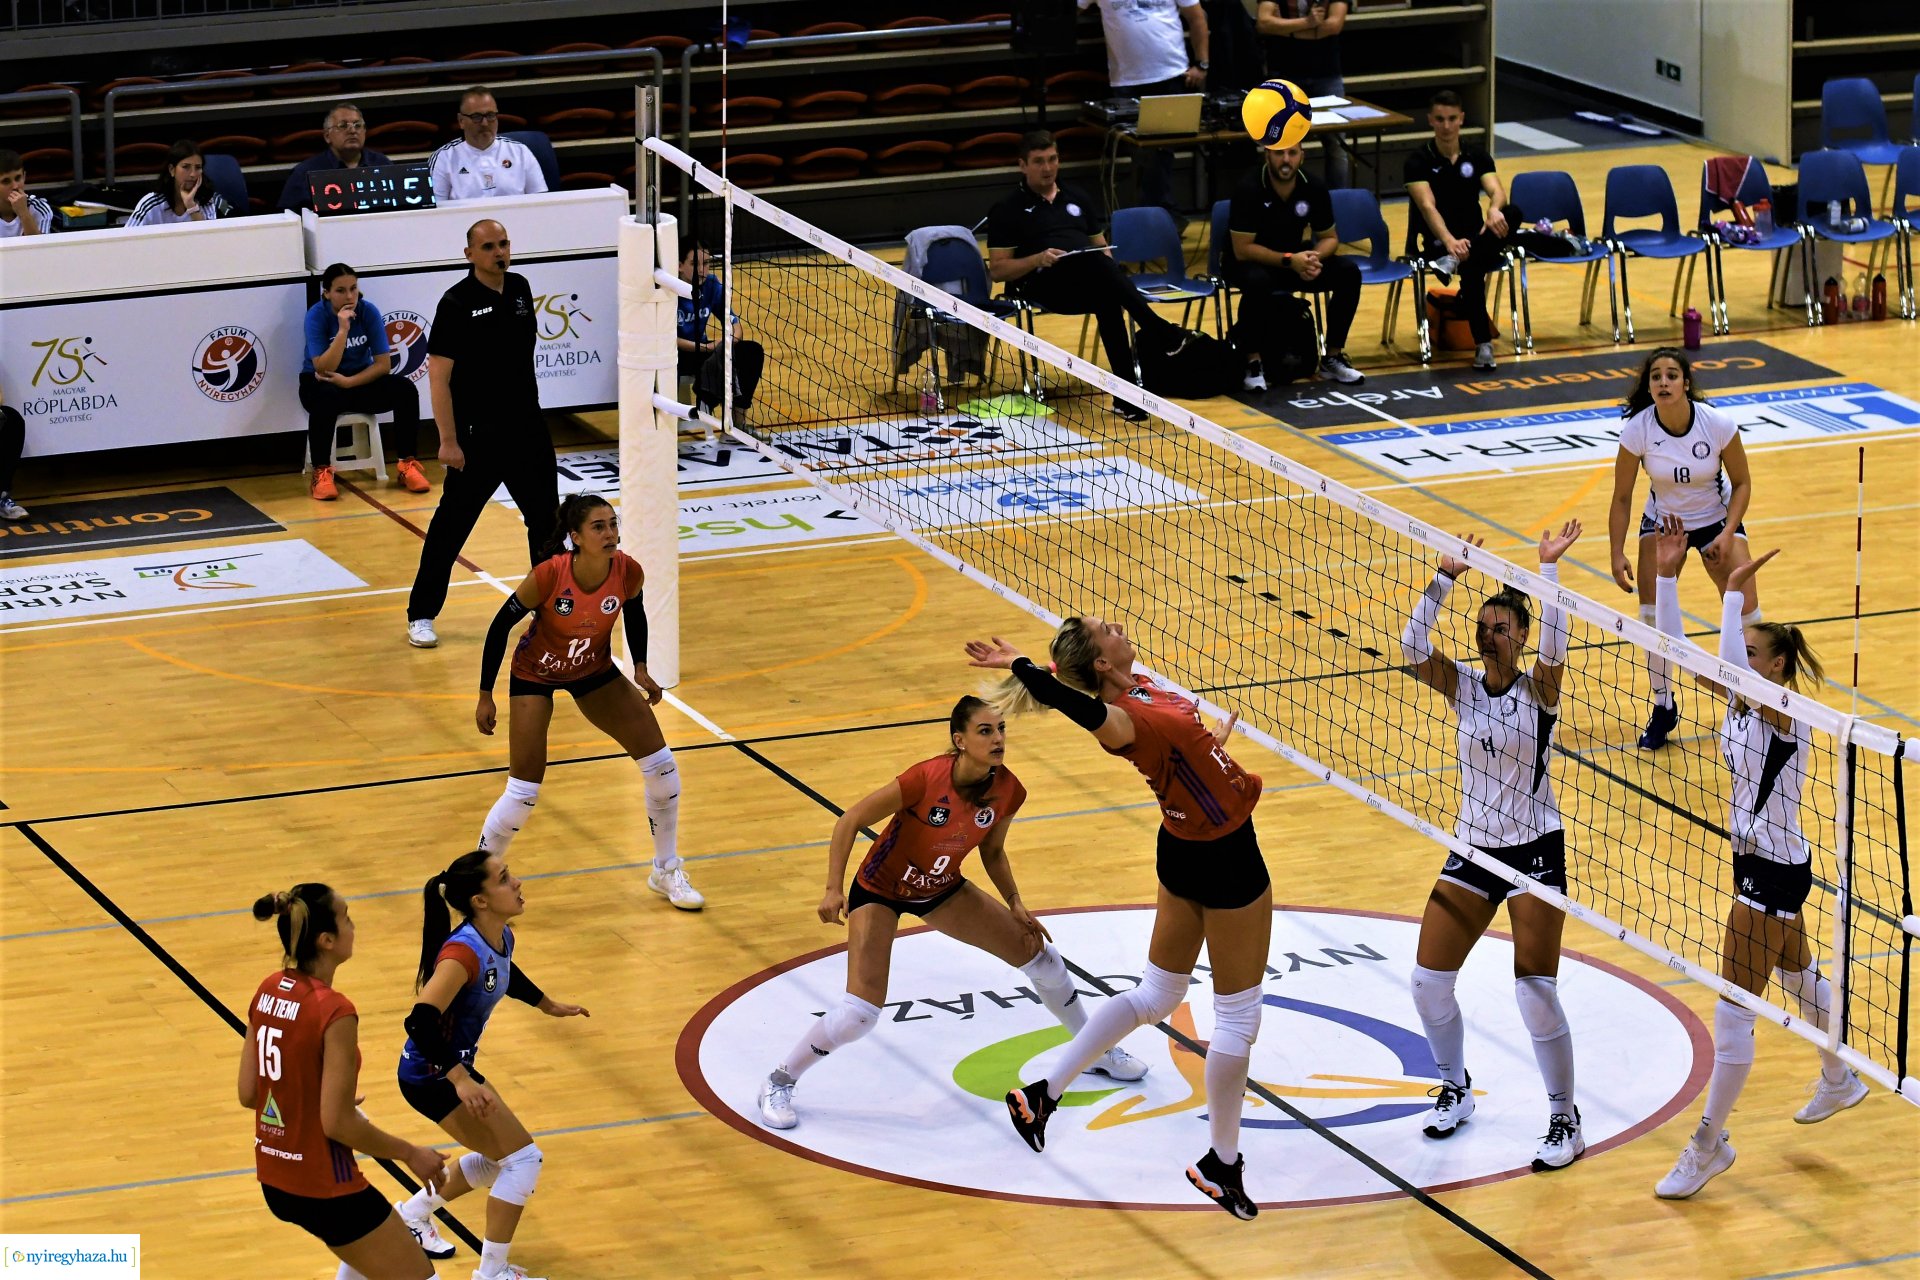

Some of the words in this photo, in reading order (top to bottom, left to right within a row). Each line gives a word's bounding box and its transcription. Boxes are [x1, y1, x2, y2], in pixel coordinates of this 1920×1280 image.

[471, 306, 493, 318] Zeus
[209, 326, 248, 341] FATUM
[539, 342, 572, 350] MAGYAR
[535, 350, 602, 369] PLABDA
[52, 386, 87, 395] MAGYAR
[23, 394, 118, 416] RÖPLABDA
[49, 413, 92, 425] SZÖVETSÉG
[1673, 466, 1691, 484] 18
[706, 493, 822, 513] Korrekt.
[1557, 590, 1578, 611] FATUM
[567, 637, 591, 659] 12
[1718, 664, 1740, 686] FATUM
[929, 855, 950, 876] 9
[256, 993, 273, 1015] ANA
[273, 998, 301, 1021] TIEMI
[256, 1024, 283, 1081] 15
